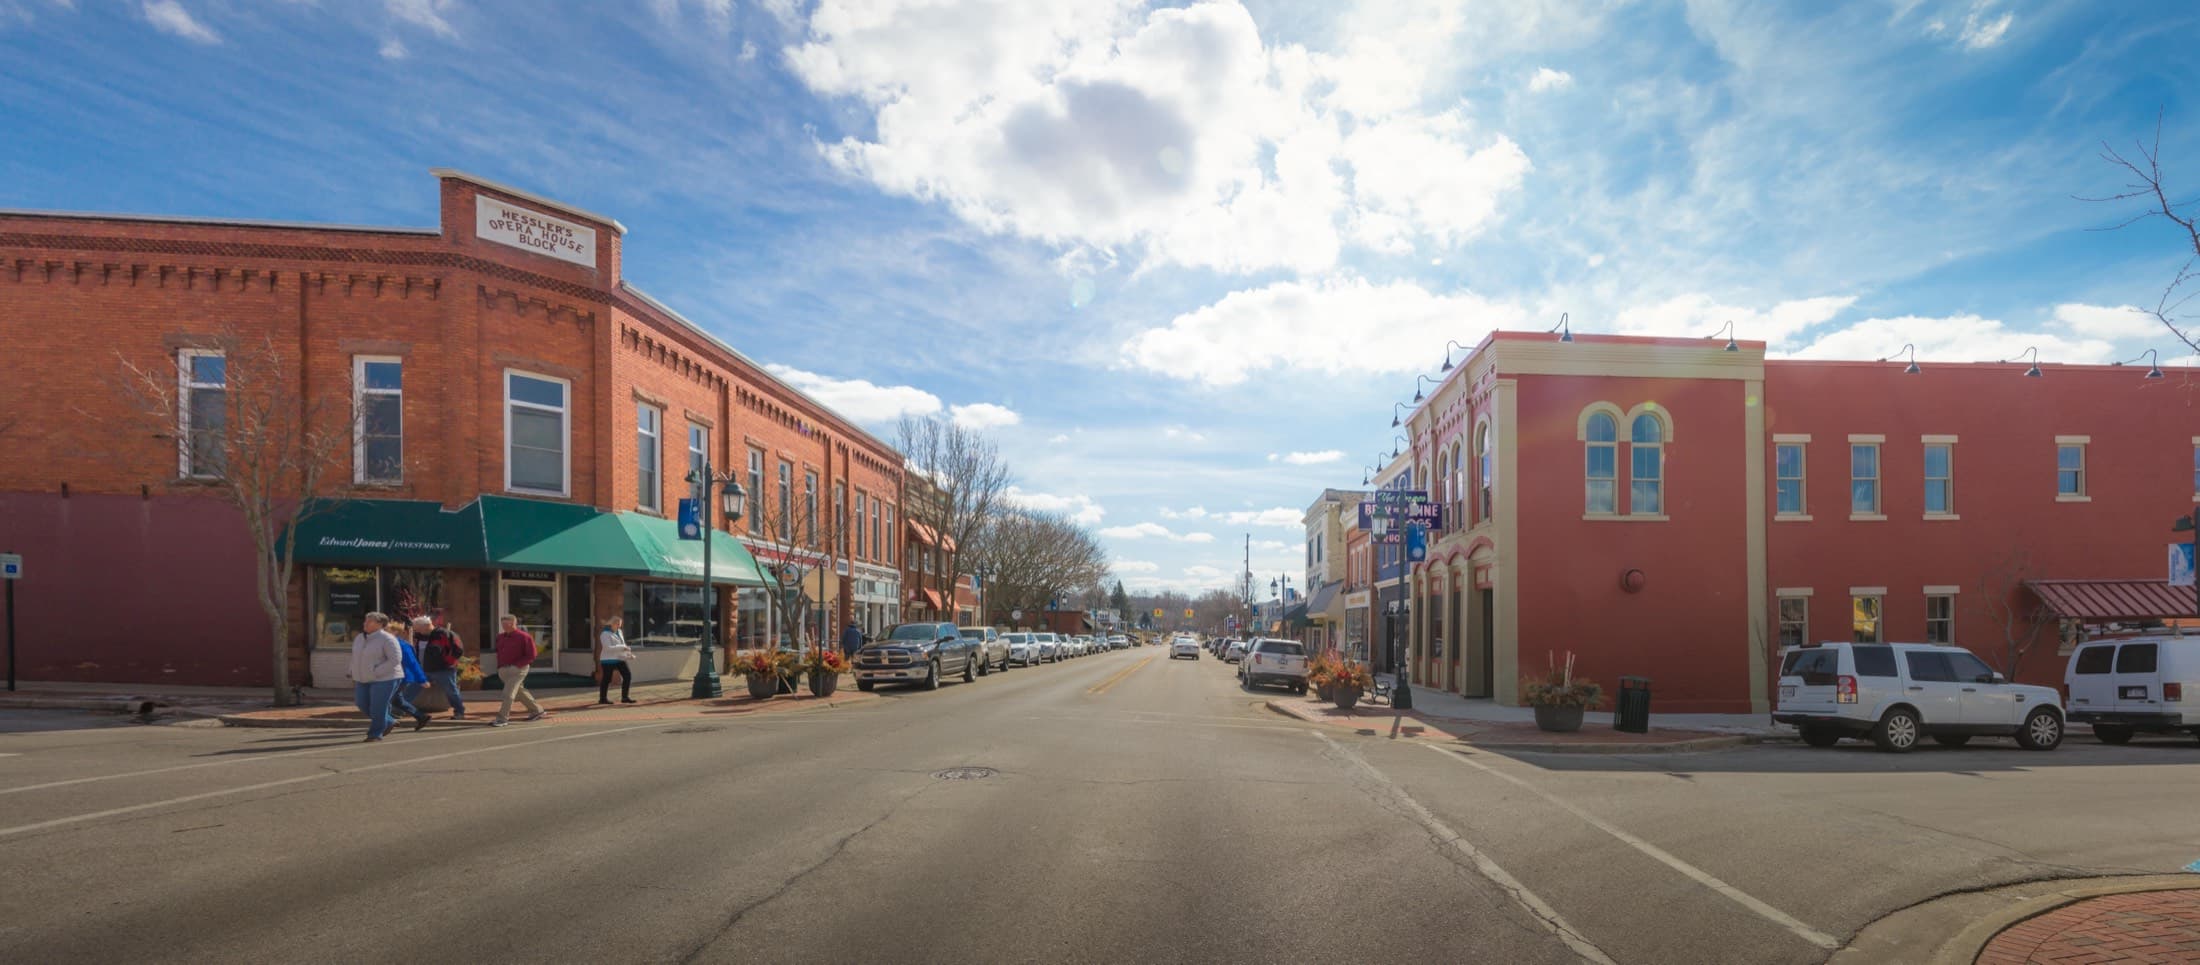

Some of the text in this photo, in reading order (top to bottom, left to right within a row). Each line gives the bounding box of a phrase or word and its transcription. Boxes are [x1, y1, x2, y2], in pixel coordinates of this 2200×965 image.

[501, 209, 573, 237] HESSLER'S
[488, 219, 585, 254] OPERA HOUSE
[519, 233, 557, 253] BLOCK
[394, 541, 451, 550] INVESTMENTS
